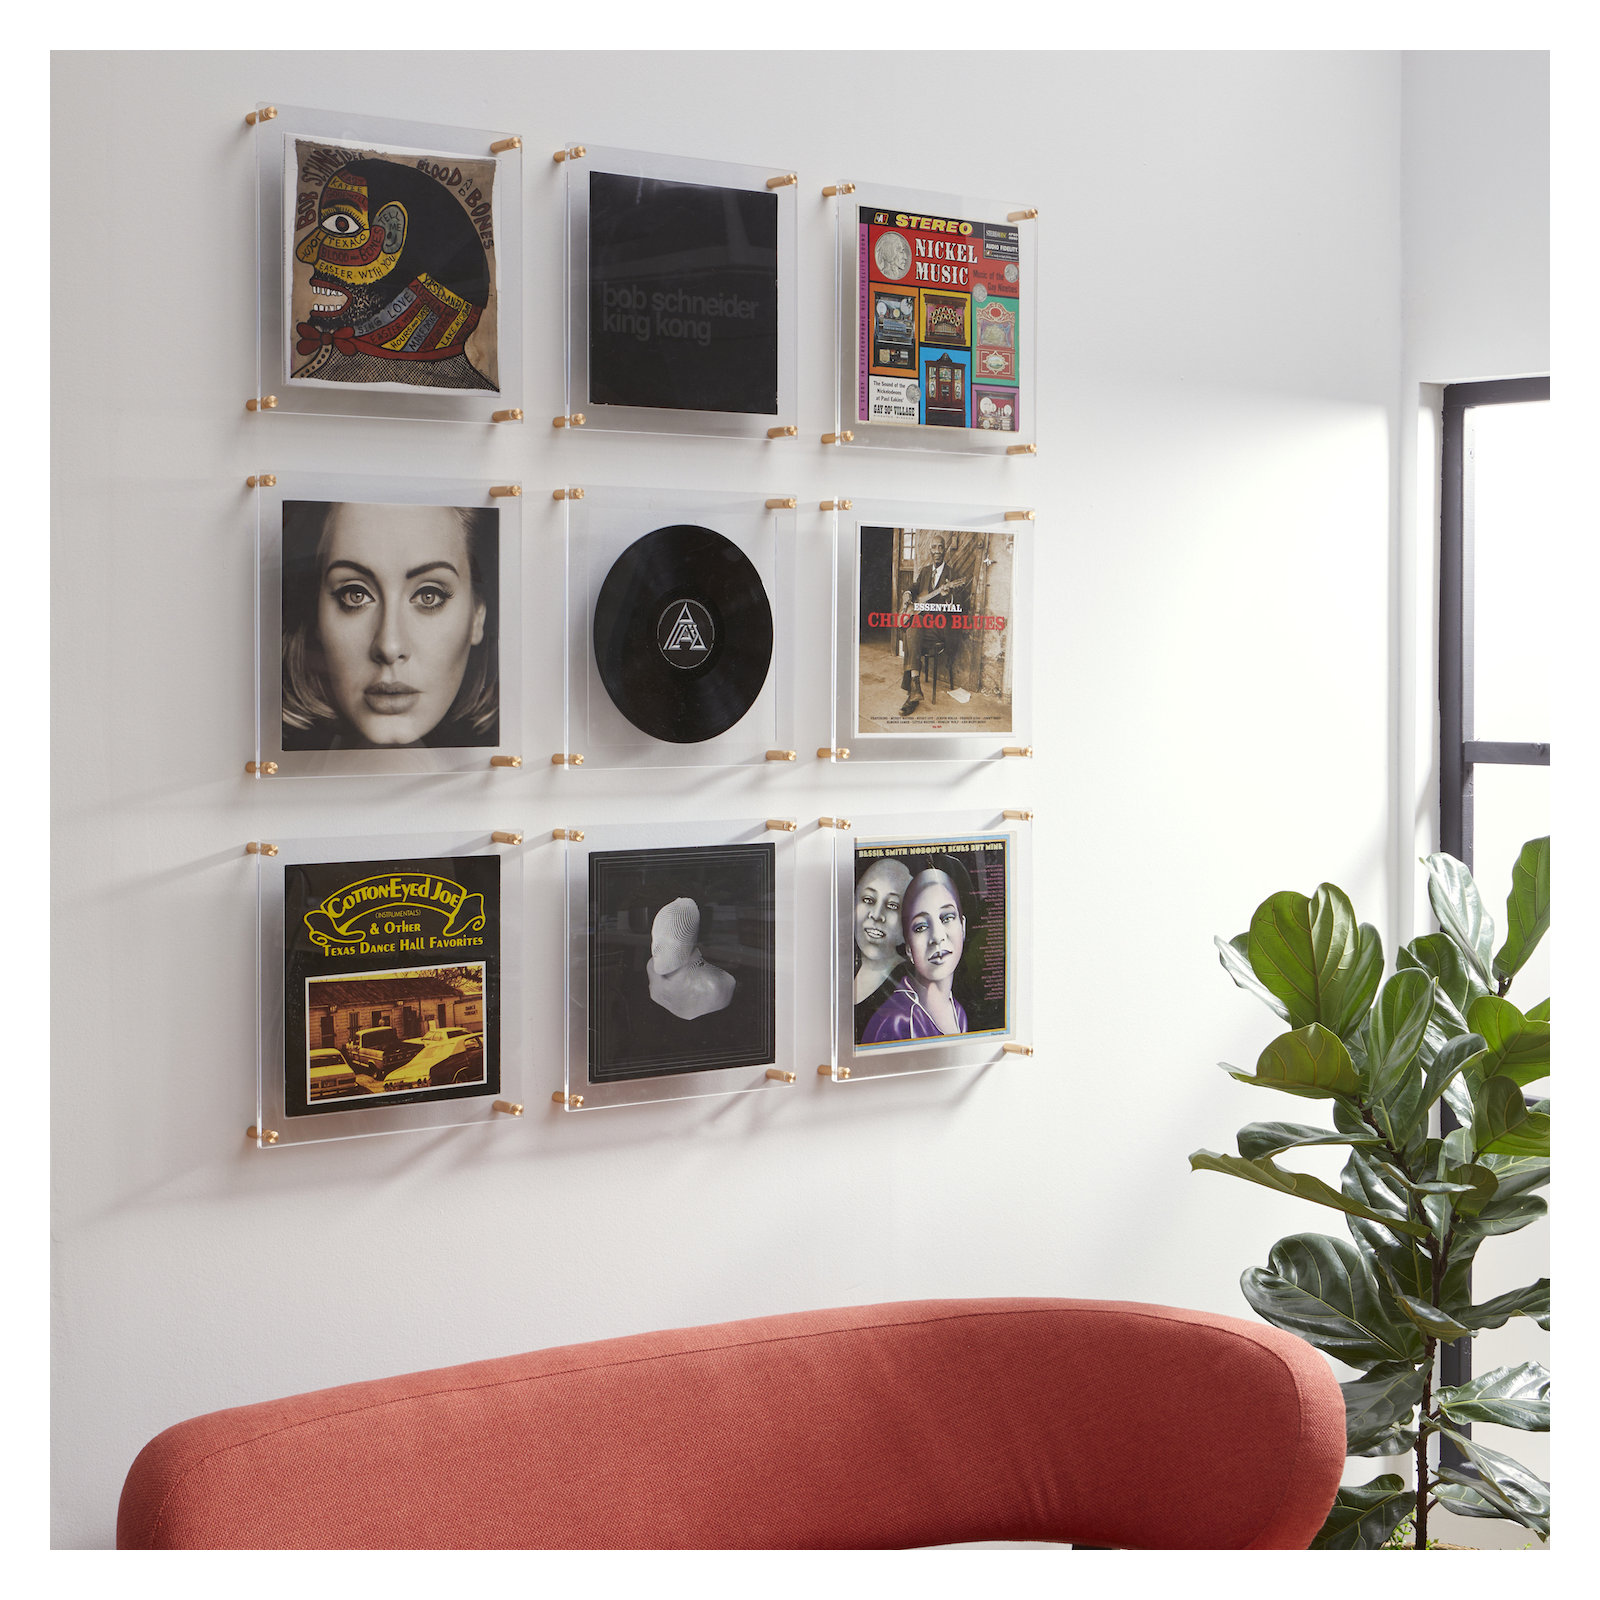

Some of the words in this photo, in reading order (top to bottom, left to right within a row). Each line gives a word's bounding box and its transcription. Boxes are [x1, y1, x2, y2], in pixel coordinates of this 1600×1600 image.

[329, 177, 363, 193] KATIE
[296, 191, 319, 231] BOB
[416, 159, 463, 186] BLOOD
[465, 187, 495, 250] BONES
[377, 211, 400, 225] TELL
[389, 222, 402, 231] ME
[895, 213, 973, 236] STEREO
[328, 233, 367, 248] TEXACO
[914, 238, 978, 264] NICKEL
[319, 262, 353, 279] EASIER
[358, 265, 384, 279] WITH
[380, 255, 396, 269] YOU
[914, 261, 969, 286] MUSIC
[386, 291, 414, 319] LOVE
[603, 282, 647, 310] bob
[651, 288, 760, 319] schneider
[390, 326, 413, 349] HOURS
[408, 326, 427, 351] MAKE
[440, 328, 456, 346] LAKE
[603, 308, 650, 341] king
[655, 312, 712, 346] kong
[913, 602, 963, 613] ESSENTIAL
[867, 612, 947, 630] CHICAGO
[951, 614, 1006, 631] BLUES
[858, 849, 884, 858] BESSIE
[884, 848, 908, 857] SMITH
[909, 845, 947, 856] NOBODY'S
[947, 844, 970, 853] BLUES
[970, 843, 985, 852] BUT
[985, 842, 1004, 851] MINE
[369, 922, 380, 936] &
